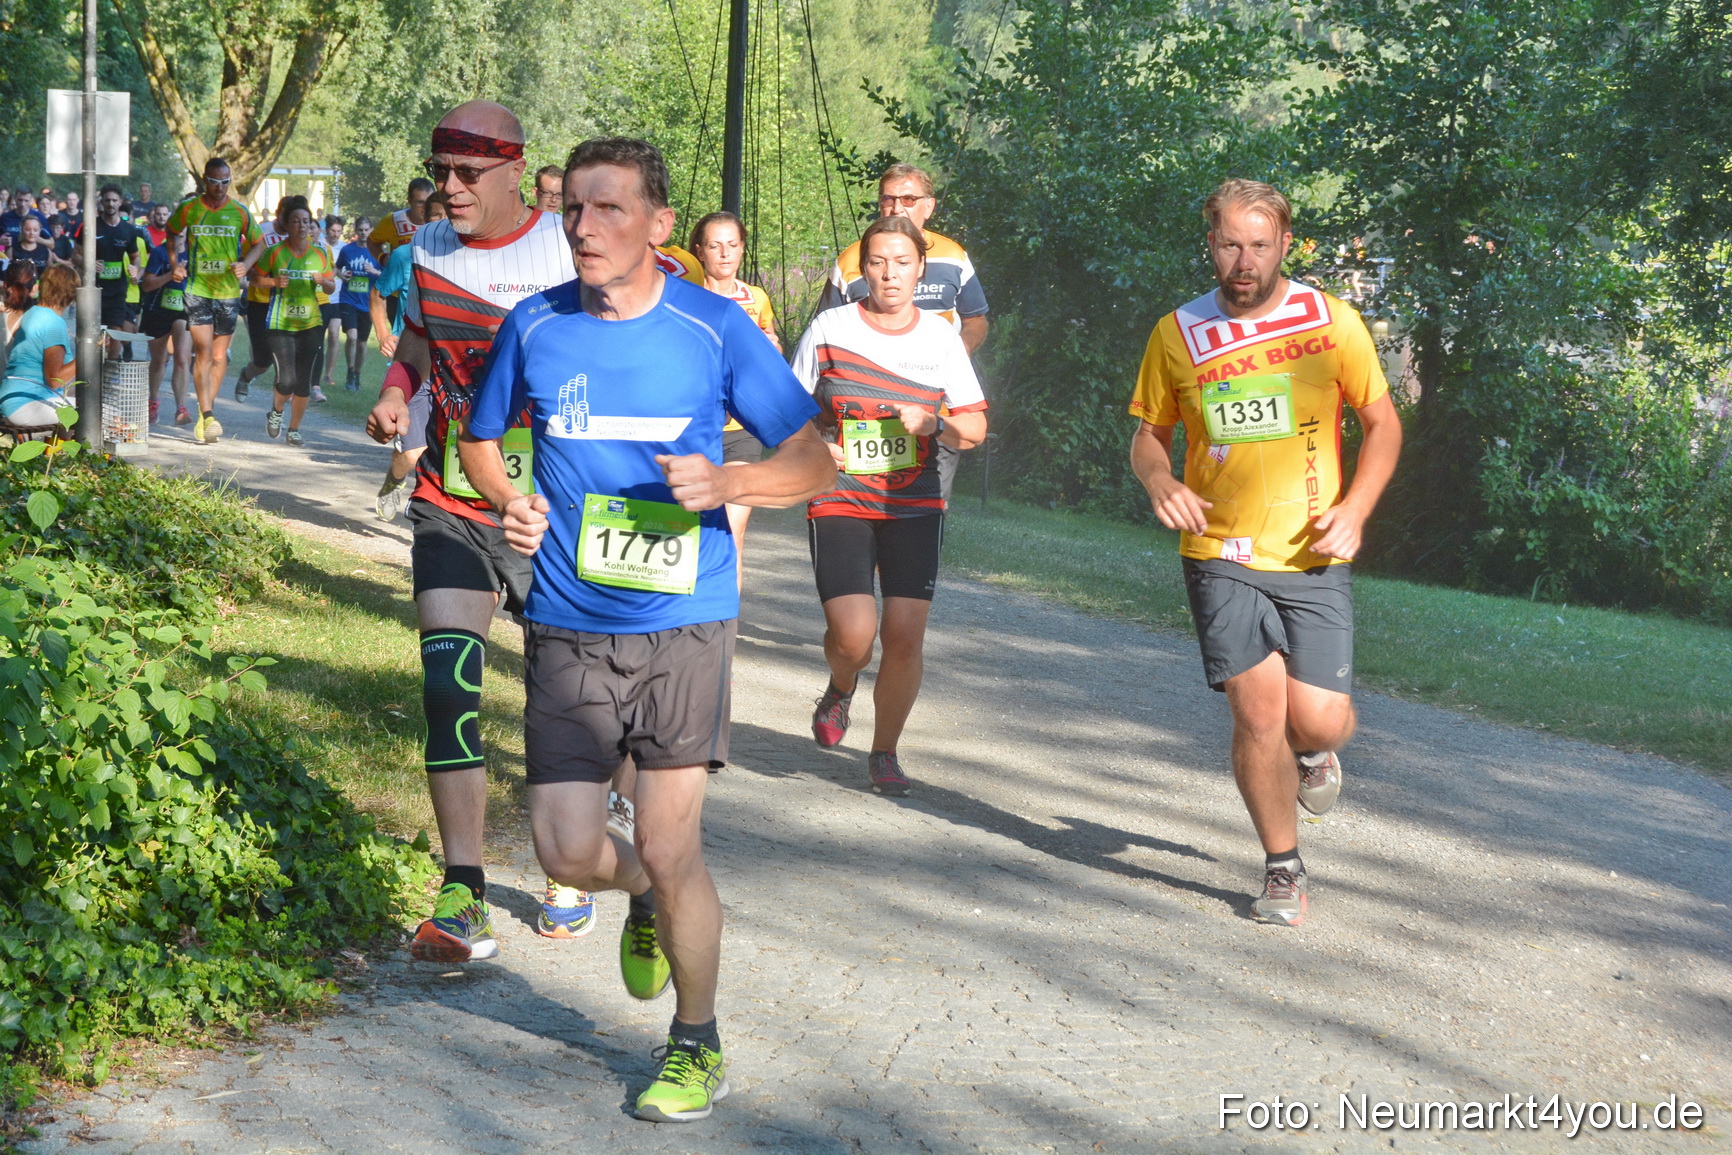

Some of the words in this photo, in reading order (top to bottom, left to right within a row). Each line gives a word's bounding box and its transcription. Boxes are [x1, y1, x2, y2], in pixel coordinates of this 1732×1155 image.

[191, 225, 236, 237] BOCK
[202, 261, 220, 269] 214
[167, 296, 181, 304] 521
[539, 300, 559, 311] JAKO
[289, 306, 306, 315] 213
[898, 362, 940, 372] NEUMARKT
[1196, 355, 1260, 391] MAX
[1265, 335, 1336, 365] BÖGL
[1214, 397, 1278, 426] 1331
[1244, 422, 1278, 431] Alexander
[853, 437, 907, 459] 1908
[596, 528, 683, 567] 1779
[583, 567, 639, 580] Schornsteintechnik
[604, 561, 625, 571] Kohl
[627, 563, 670, 577] Wolfgang
